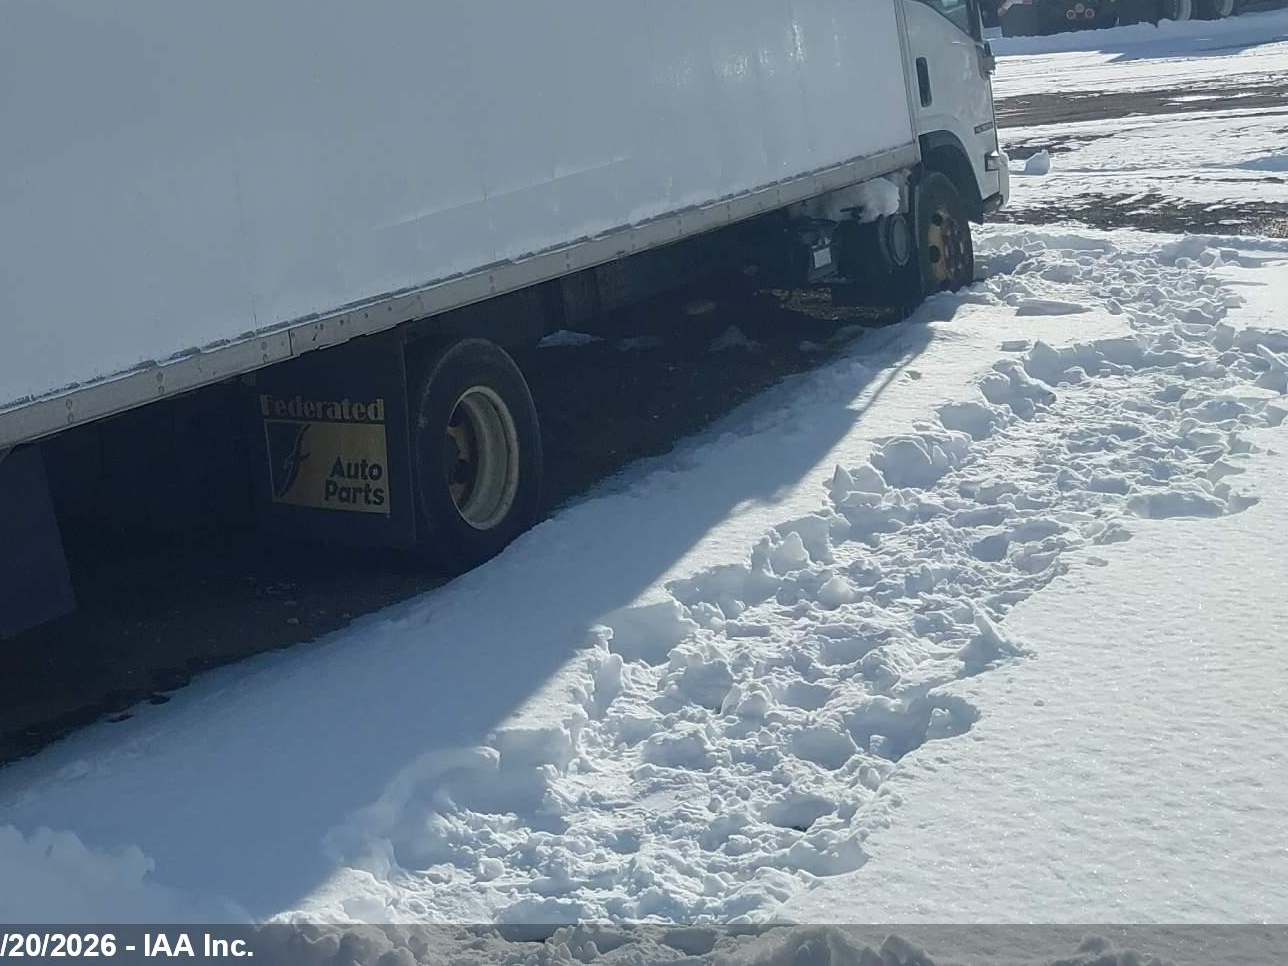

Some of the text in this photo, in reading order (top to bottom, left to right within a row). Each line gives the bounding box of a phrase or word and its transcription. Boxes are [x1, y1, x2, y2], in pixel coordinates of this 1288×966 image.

[260, 394, 385, 421] Federated
[329, 457, 383, 480] Auto
[324, 479, 385, 506] Parts
